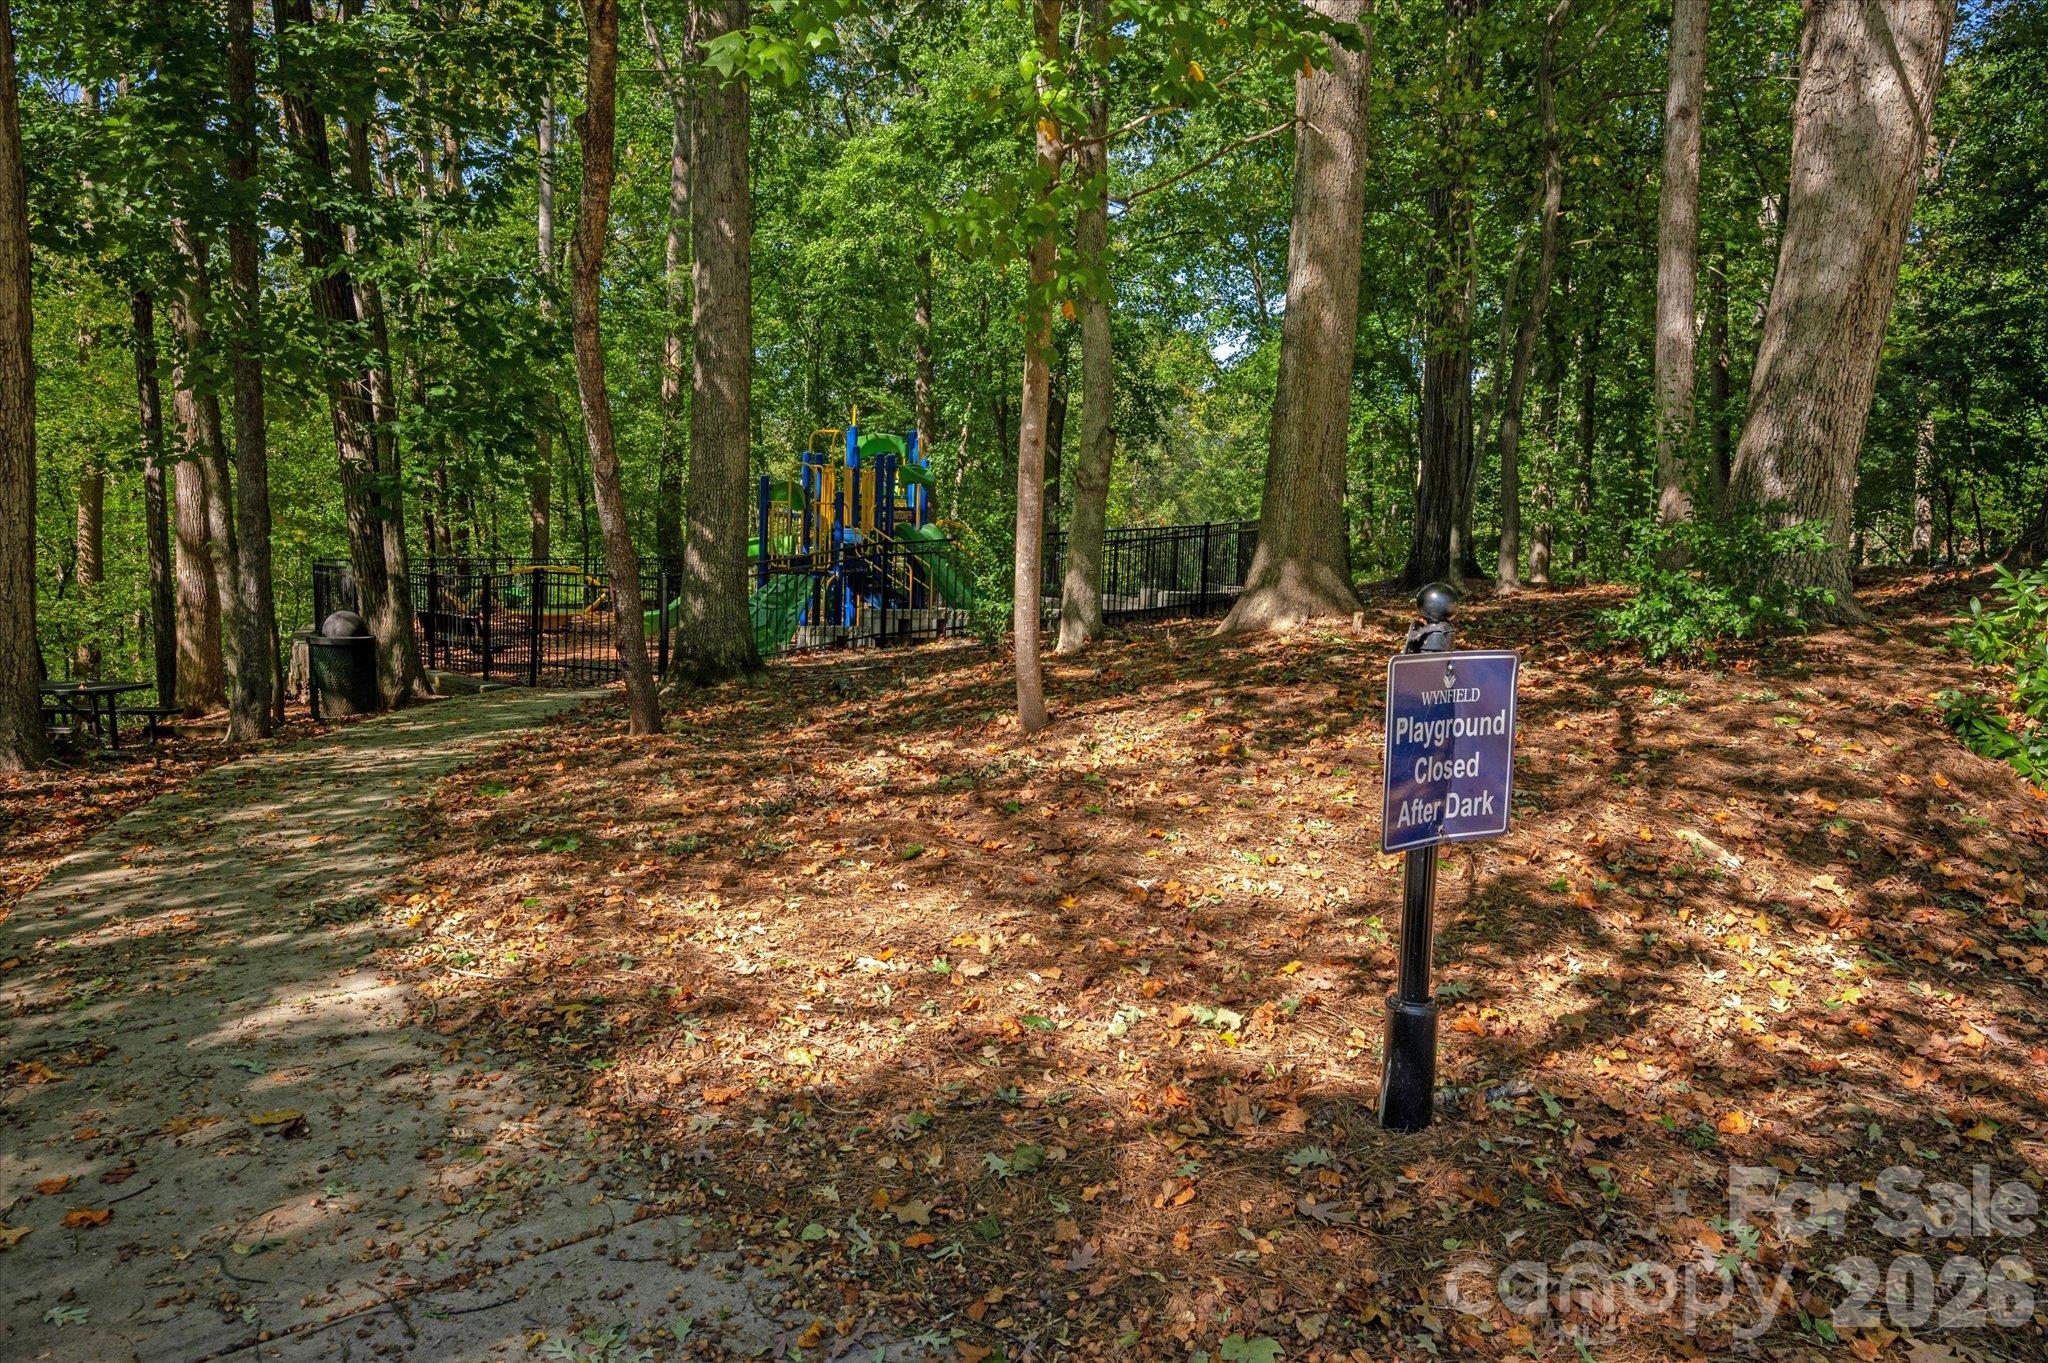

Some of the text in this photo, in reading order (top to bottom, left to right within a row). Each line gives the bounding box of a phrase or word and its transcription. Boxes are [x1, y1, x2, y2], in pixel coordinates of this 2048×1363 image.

[1421, 687, 1481, 706] WYNFIELD
[1396, 709, 1506, 749] Playground
[1414, 752, 1480, 784] Closed
[1397, 790, 1494, 828] After Dark
